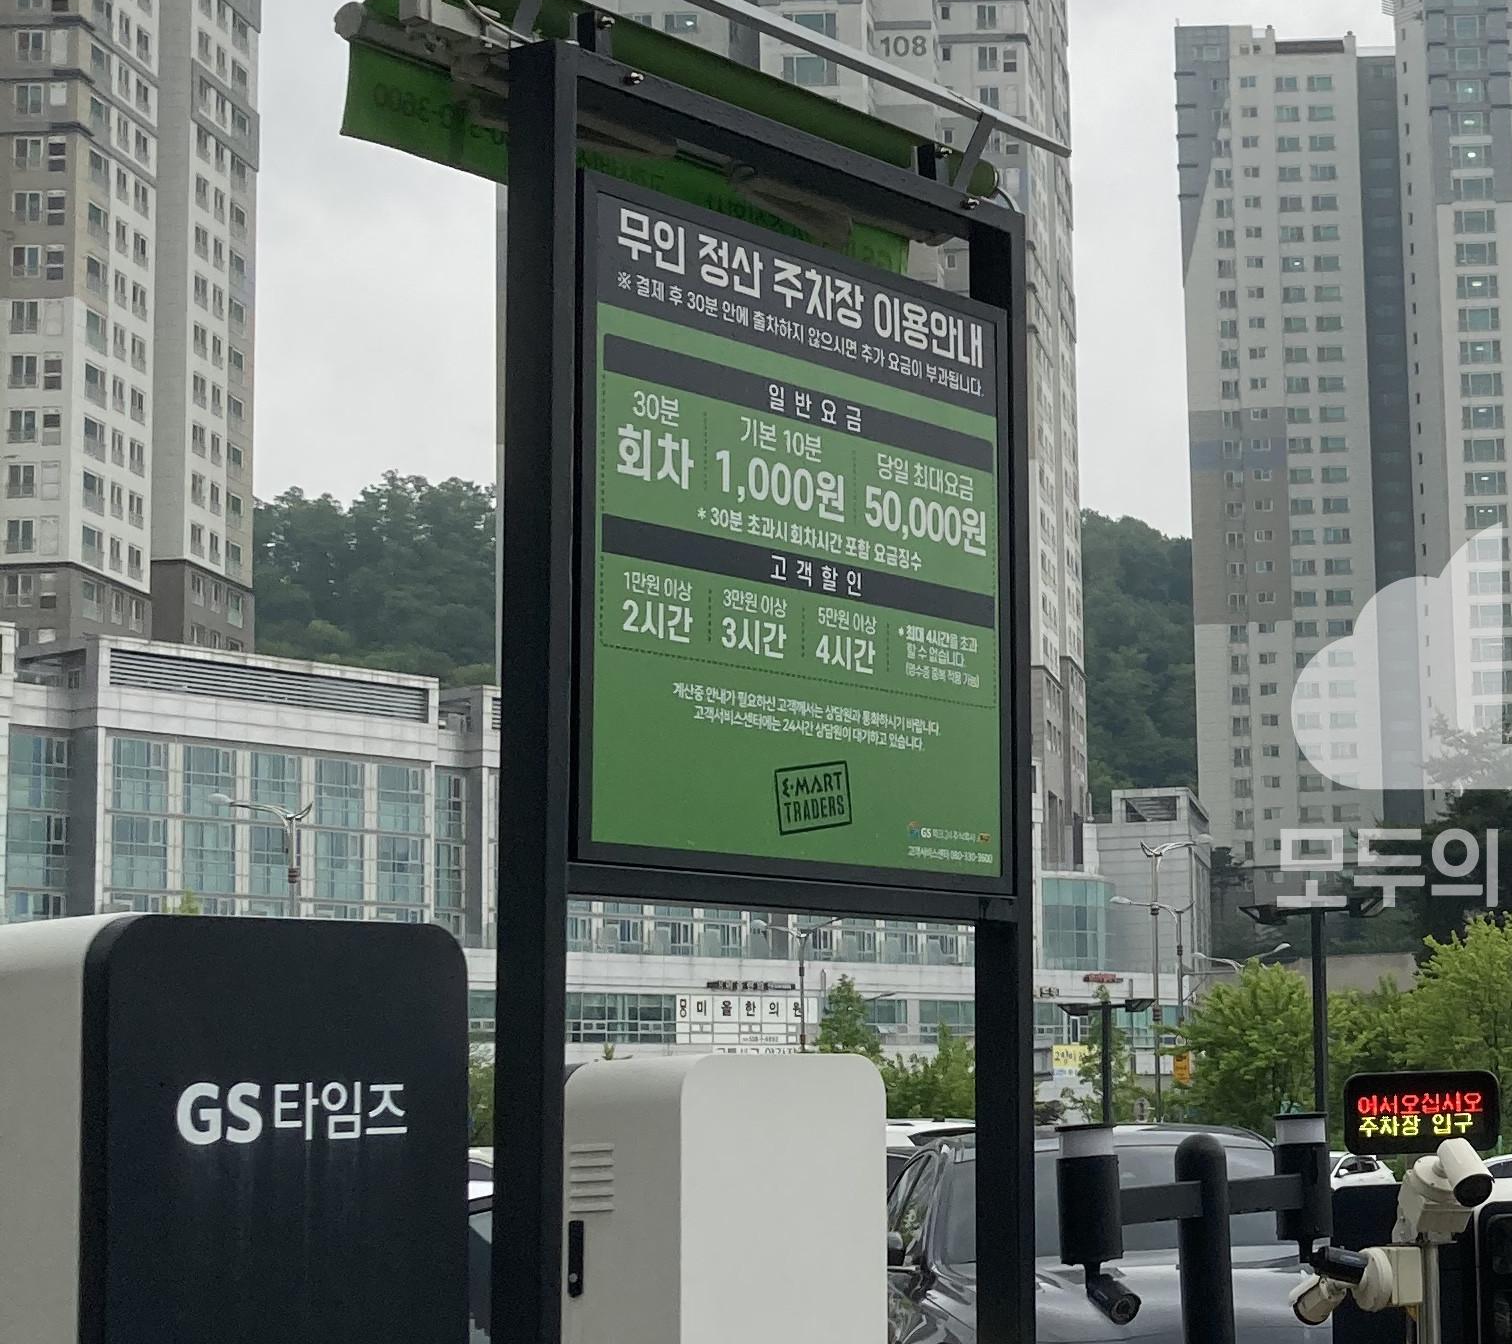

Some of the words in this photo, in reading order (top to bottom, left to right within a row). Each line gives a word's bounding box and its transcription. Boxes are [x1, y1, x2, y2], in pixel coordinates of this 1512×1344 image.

[879, 35, 928, 57] 108
[618, 208, 686, 275] 무인
[698, 233, 763, 299] 정산
[774, 258, 864, 329] 주차장
[874, 293, 983, 368] 이용안내
[636, 275, 665, 302] 결제
[669, 285, 683, 306] 후
[687, 292, 719, 318] 30분
[722, 301, 749, 327] 안에
[753, 311, 804, 344] 출차하지
[808, 327, 857, 359] 않으시면
[862, 344, 885, 368] 추가
[888, 352, 922, 379] 요금이
[926, 363, 985, 397] 부과됩니다.
[633, 390, 680, 427] 30분
[617, 423, 694, 490] 회차
[740, 416, 777, 452] 기본
[783, 429, 822, 463] 10분
[715, 450, 845, 522] 1,000원
[877, 453, 909, 485] 당일
[913, 462, 974, 502] 최대요금
[710, 507, 743, 532] 30분
[747, 514, 788, 542] 초과시
[790, 523, 843, 554] 회차시간
[845, 536, 870, 560] 포함
[874, 543, 922, 572] 요금징수
[864, 485, 987, 556] 50,000원
[623, 571, 660, 597] 1만원
[664, 578, 692, 602] 이상
[723, 589, 758, 614] 3만원
[761, 595, 787, 619] 이상
[622, 600, 693, 644] 2시간
[721, 617, 787, 658] 3시간
[818, 606, 850, 631] 5만원
[853, 613, 877, 635] 이상
[816, 634, 876, 675] 4시간
[918, 646, 928, 660] 수
[672, 682, 704, 701] 계산중
[706, 687, 736, 706] 안내가
[737, 691, 776, 711] 필요하신
[782, 718, 815, 737] 24시간
[815, 722, 851, 742] 상담원이
[852, 728, 887, 746] 대기하고
[784, 794, 845, 824] TRADERS
[1357, 1090, 1483, 1115] 어서오십시오
[1359, 1114, 1421, 1138] 주차장
[1432, 1112, 1473, 1135] 입구
